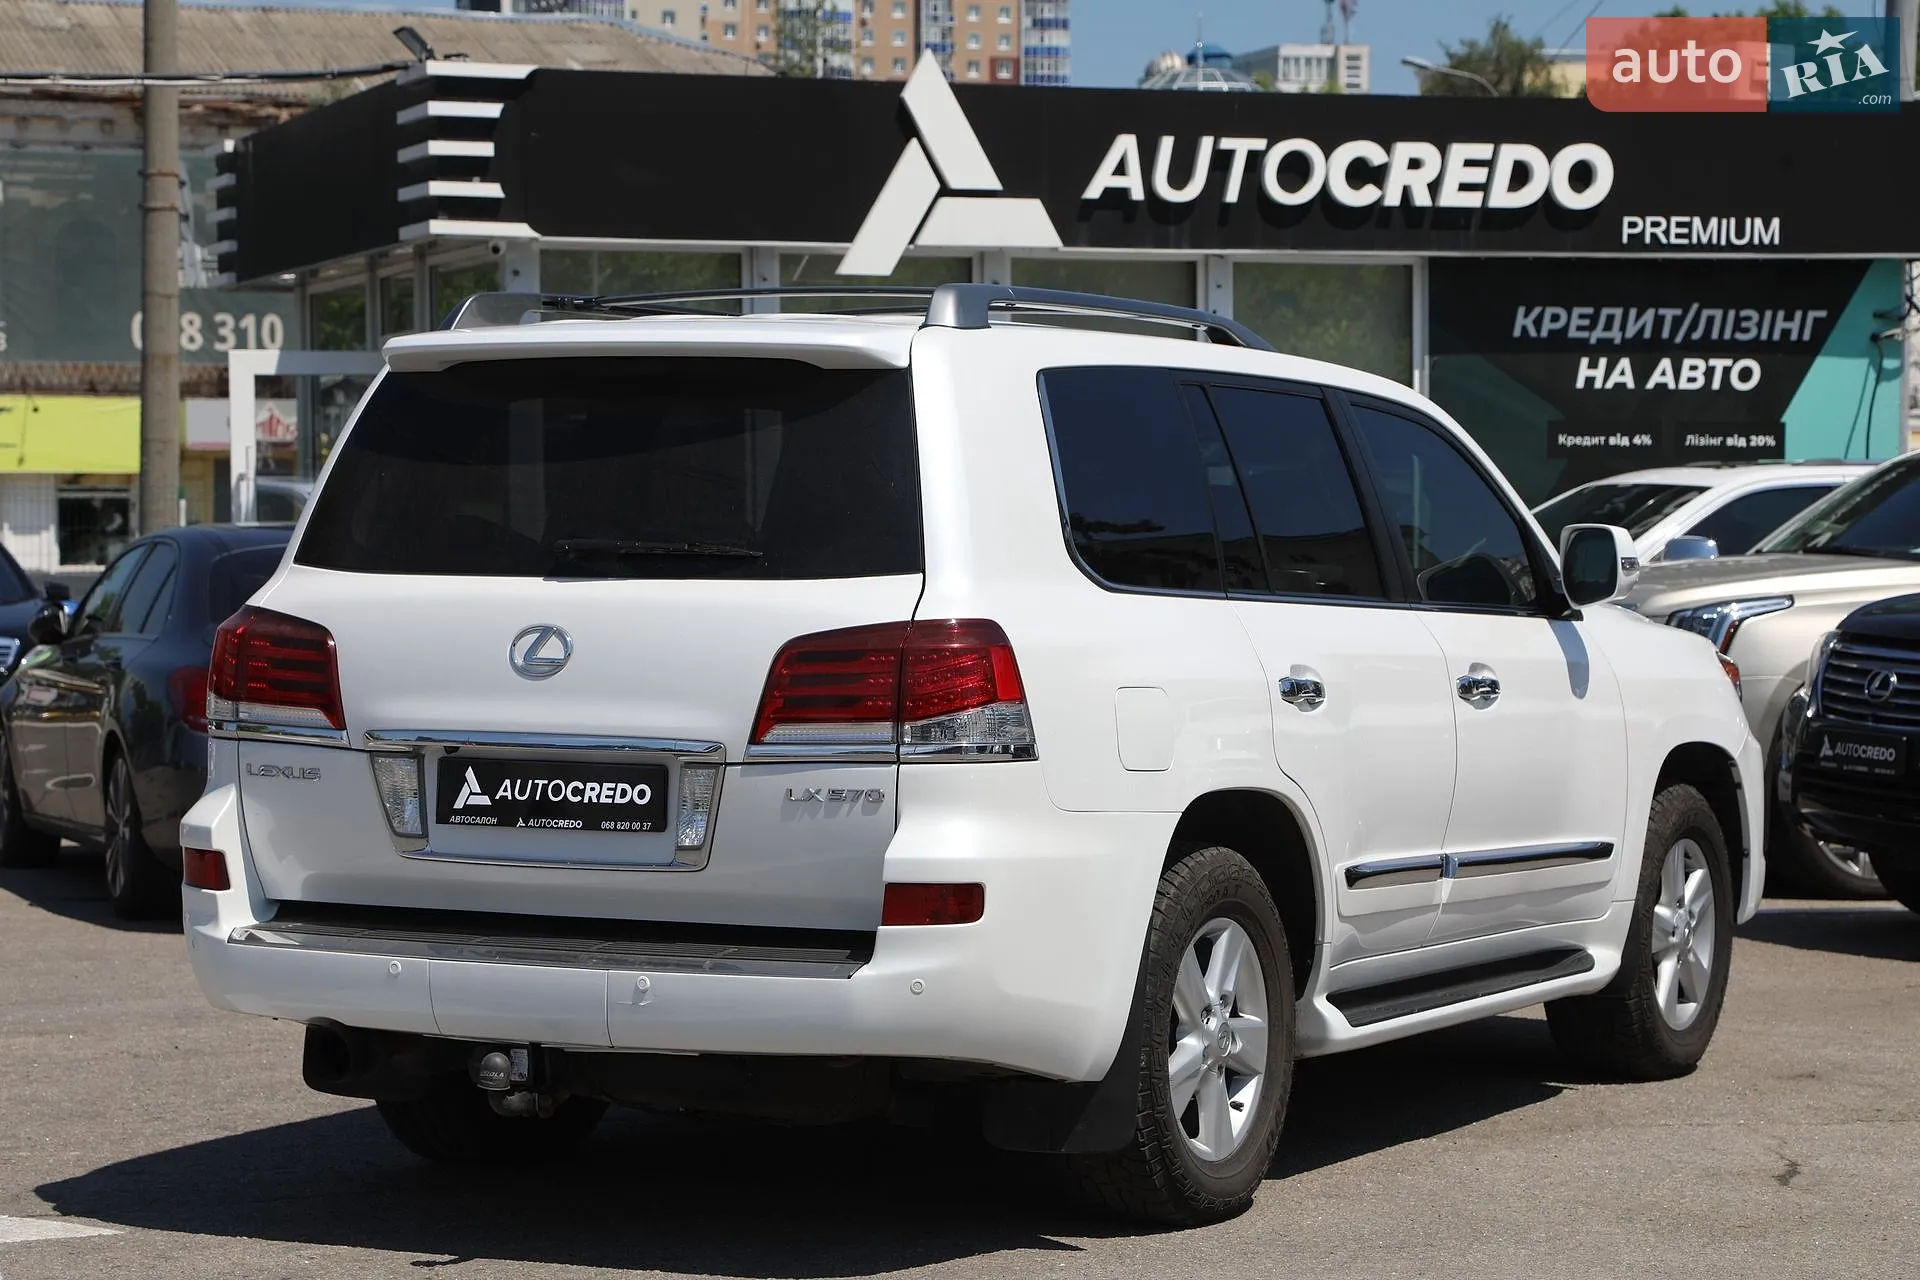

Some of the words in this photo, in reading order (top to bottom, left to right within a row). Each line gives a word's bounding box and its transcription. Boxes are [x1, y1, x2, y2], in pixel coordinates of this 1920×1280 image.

[1080, 133, 1614, 211] AUTOCREDO
[1622, 216, 1780, 246] PREMIUM
[213, 312, 285, 350] 310
[1512, 302, 1828, 344] КРЕДИТ/ЛІЗІНГ
[1575, 356, 1636, 390] НА
[1646, 357, 1762, 391] АВТО
[1558, 433, 1606, 447] Кредит
[1608, 432, 1630, 447] від
[1632, 433, 1653, 446] 4%
[1685, 433, 1724, 446] Лізінг
[1725, 433, 1747, 447] від
[1749, 434, 1776, 447] 20%
[1835, 742, 1896, 761] AUTOCREDO
[246, 763, 321, 781] LEXUS
[495, 779, 651, 805] AUTOCREDO
[785, 788, 824, 802] LX
[828, 788, 885, 803] 570
[449, 815, 498, 825] АВТОСАЛОН
[527, 818, 583, 828] AUTOCREDO
[601, 821, 615, 829] 068
[616, 821, 630, 830] 820
[631, 822, 641, 830] 00
[642, 822, 652, 830] 37
